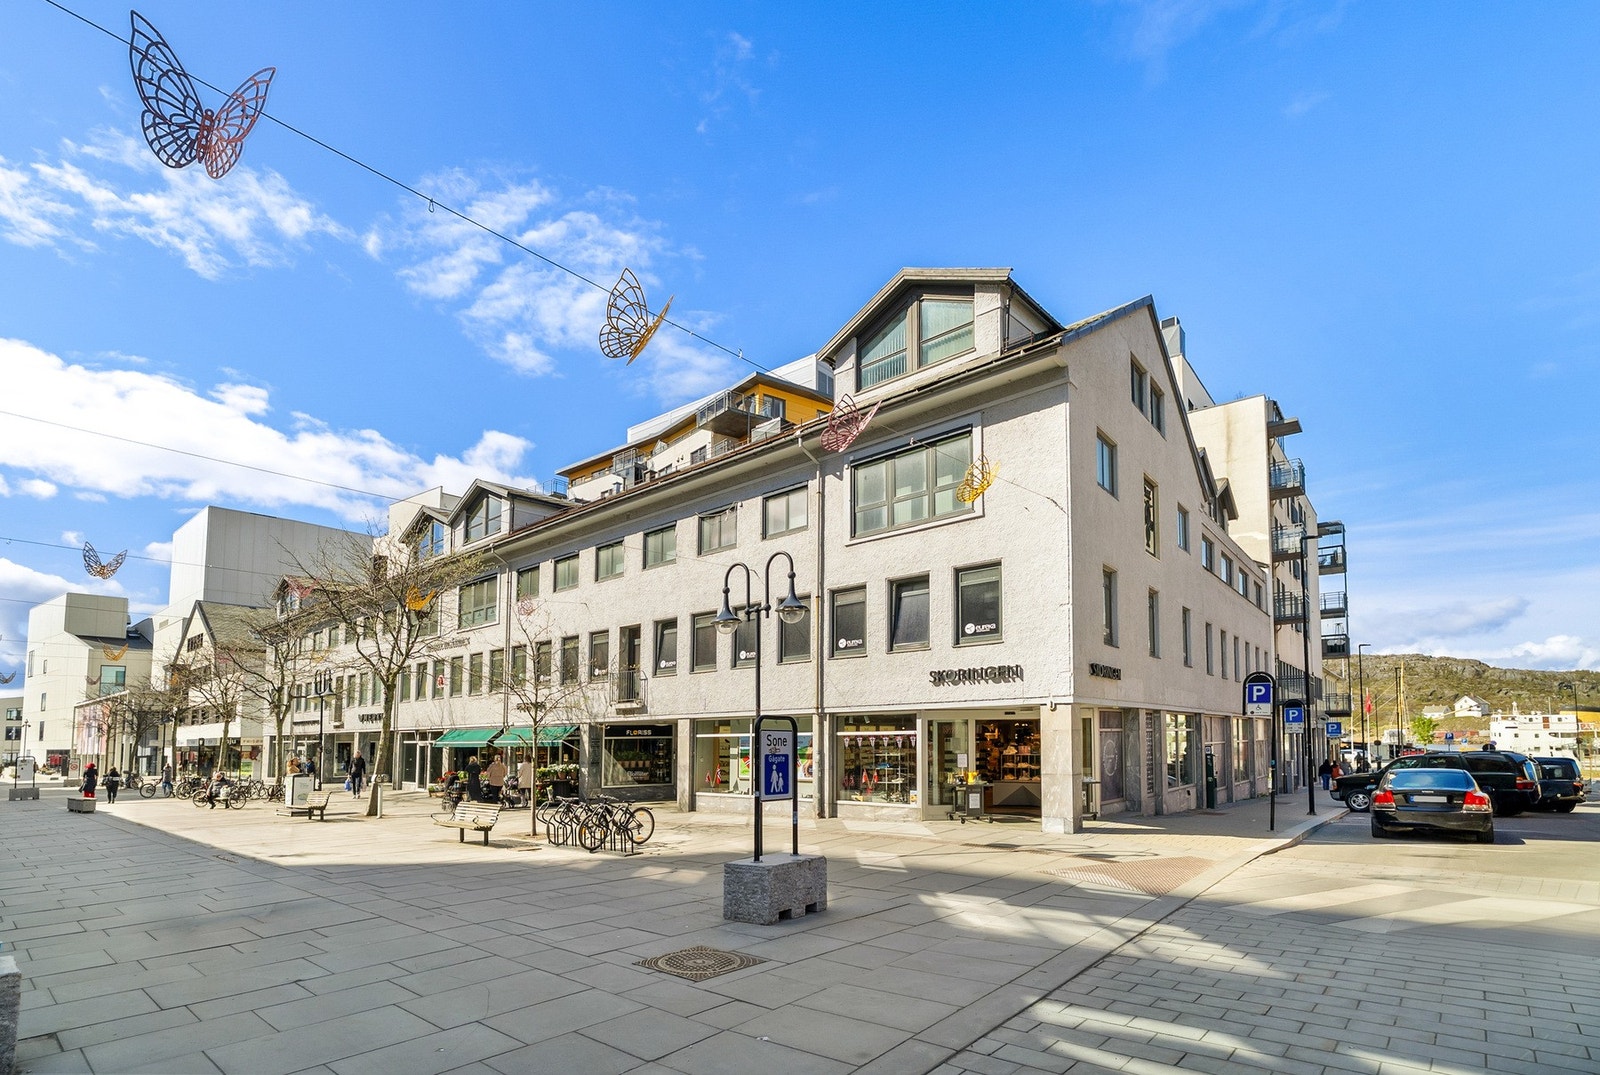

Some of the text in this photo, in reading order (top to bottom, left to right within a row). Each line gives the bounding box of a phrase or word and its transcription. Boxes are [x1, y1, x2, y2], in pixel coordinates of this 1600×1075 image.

[929, 664, 1023, 684] SKORINGEN
[1253, 685, 1265, 701] P
[1289, 709, 1298, 721] P
[1328, 723, 1337, 732] P
[766, 734, 788, 747] Sone
[768, 755, 785, 764] Gågate
